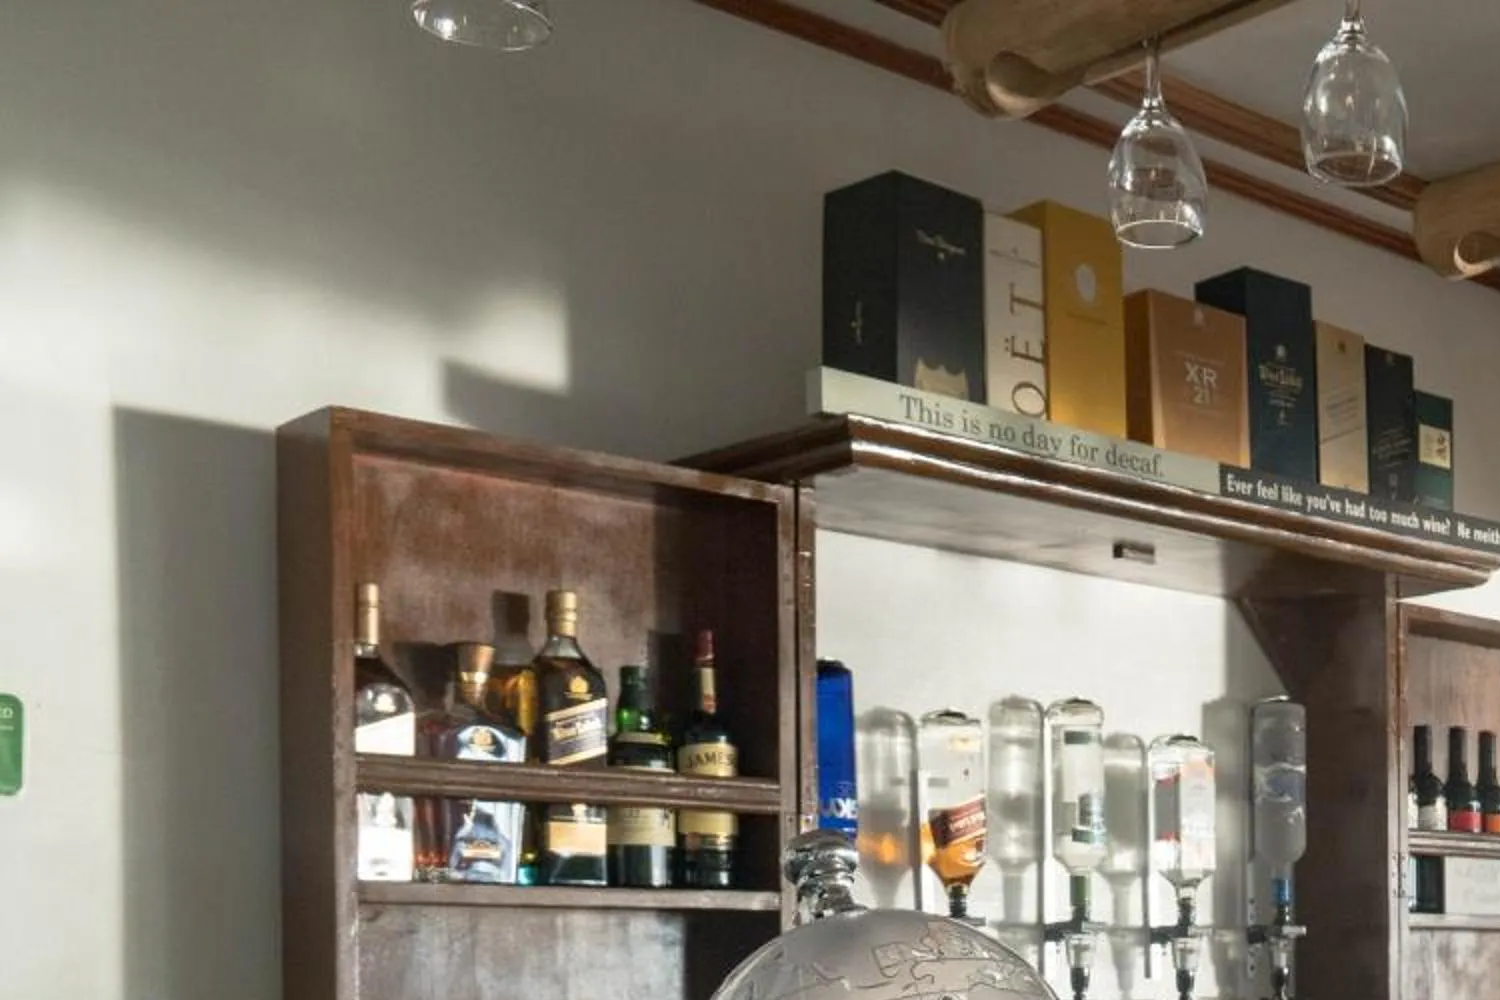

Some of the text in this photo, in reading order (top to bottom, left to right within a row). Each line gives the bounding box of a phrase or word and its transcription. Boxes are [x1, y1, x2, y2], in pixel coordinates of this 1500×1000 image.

[1003, 281, 1046, 418] OËT
[899, 394, 1165, 478] This is no day for decaf.
[1226, 472, 1253, 495] Ever
[1257, 479, 1279, 500] feel
[1281, 484, 1303, 505] like
[1306, 493, 1342, 513] you've
[1345, 498, 1366, 518] had
[1369, 506, 1388, 523] too
[1391, 511, 1420, 529] much
